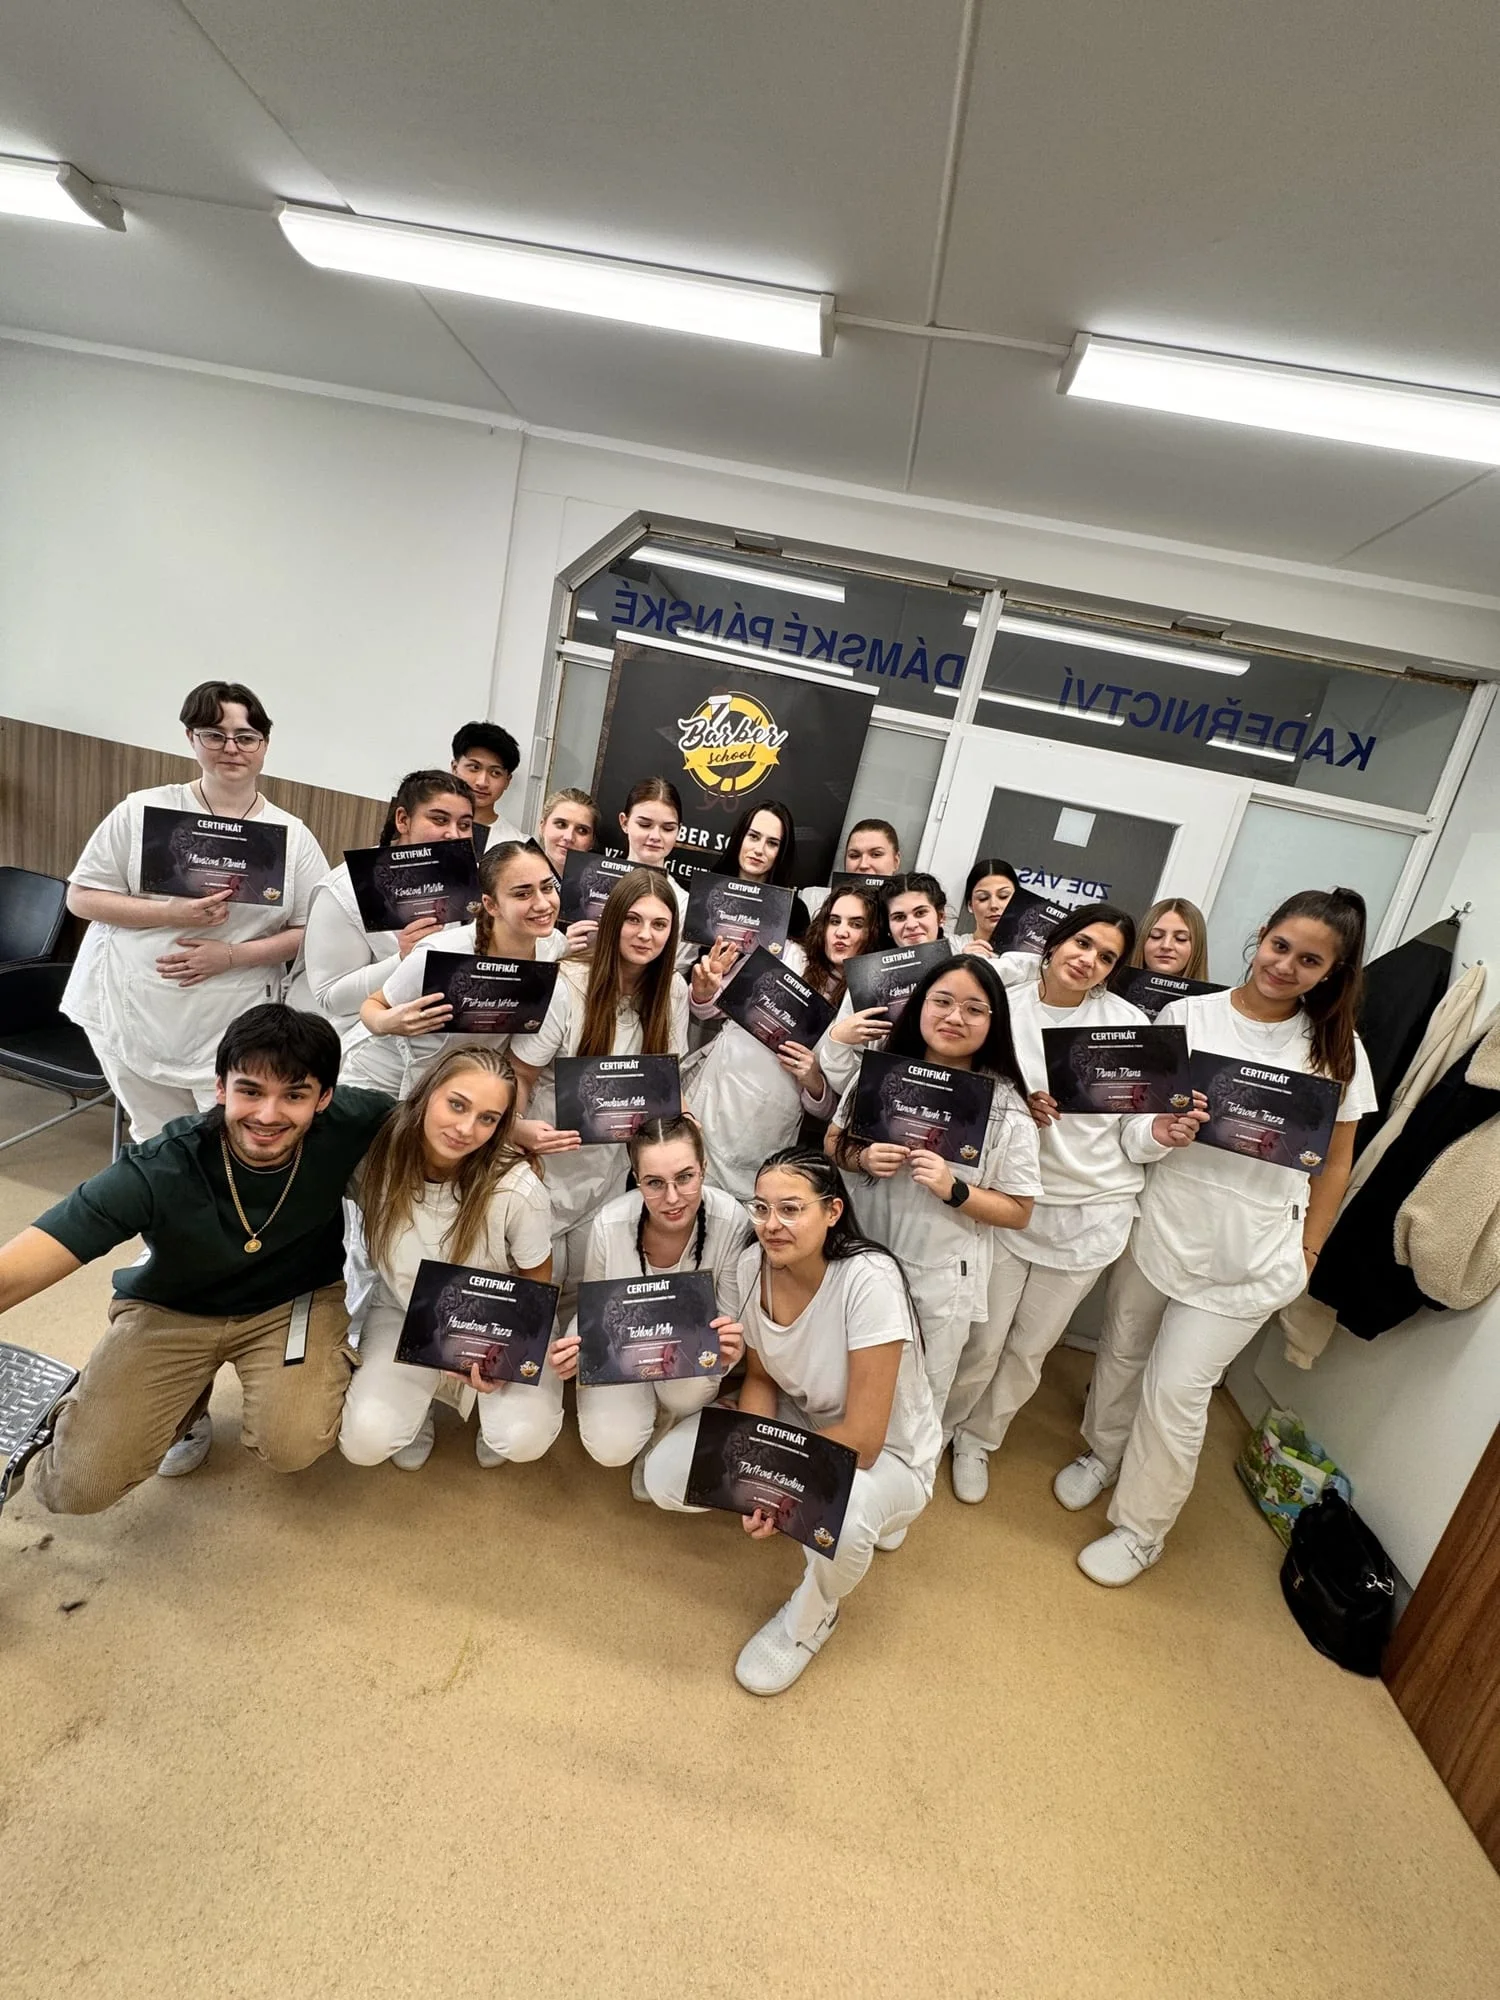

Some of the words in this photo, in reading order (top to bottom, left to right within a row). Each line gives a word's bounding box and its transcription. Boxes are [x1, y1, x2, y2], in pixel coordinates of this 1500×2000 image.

[678, 716, 788, 753] Barber
[708, 744, 756, 765] school
[197, 819, 243, 833] CERTIFIKÁT
[391, 847, 432, 860] CERTIFIKÁT
[728, 882, 761, 895] CERTIFIKÁT
[882, 950, 915, 964] CERTIFIKÁT
[476, 962, 519, 973] CERTIFIKÁT
[1150, 977, 1189, 991] CERTIFIKÁT
[1091, 1030, 1136, 1041] CERTIFIKÁT
[600, 1060, 639, 1071] CERTIFIKÁT
[908, 1065, 951, 1082] CERTIFIKÁT
[1240, 1066, 1290, 1085] CERTIFIKÁT
[1262, 1110, 1285, 1125] Tereza
[469, 1275, 515, 1292] CERTIFIKÁT
[627, 1279, 670, 1294] CERTIFIKÁT
[491, 1322, 512, 1337] Tereza
[756, 1423, 807, 1446] CERTIFIKÁT
